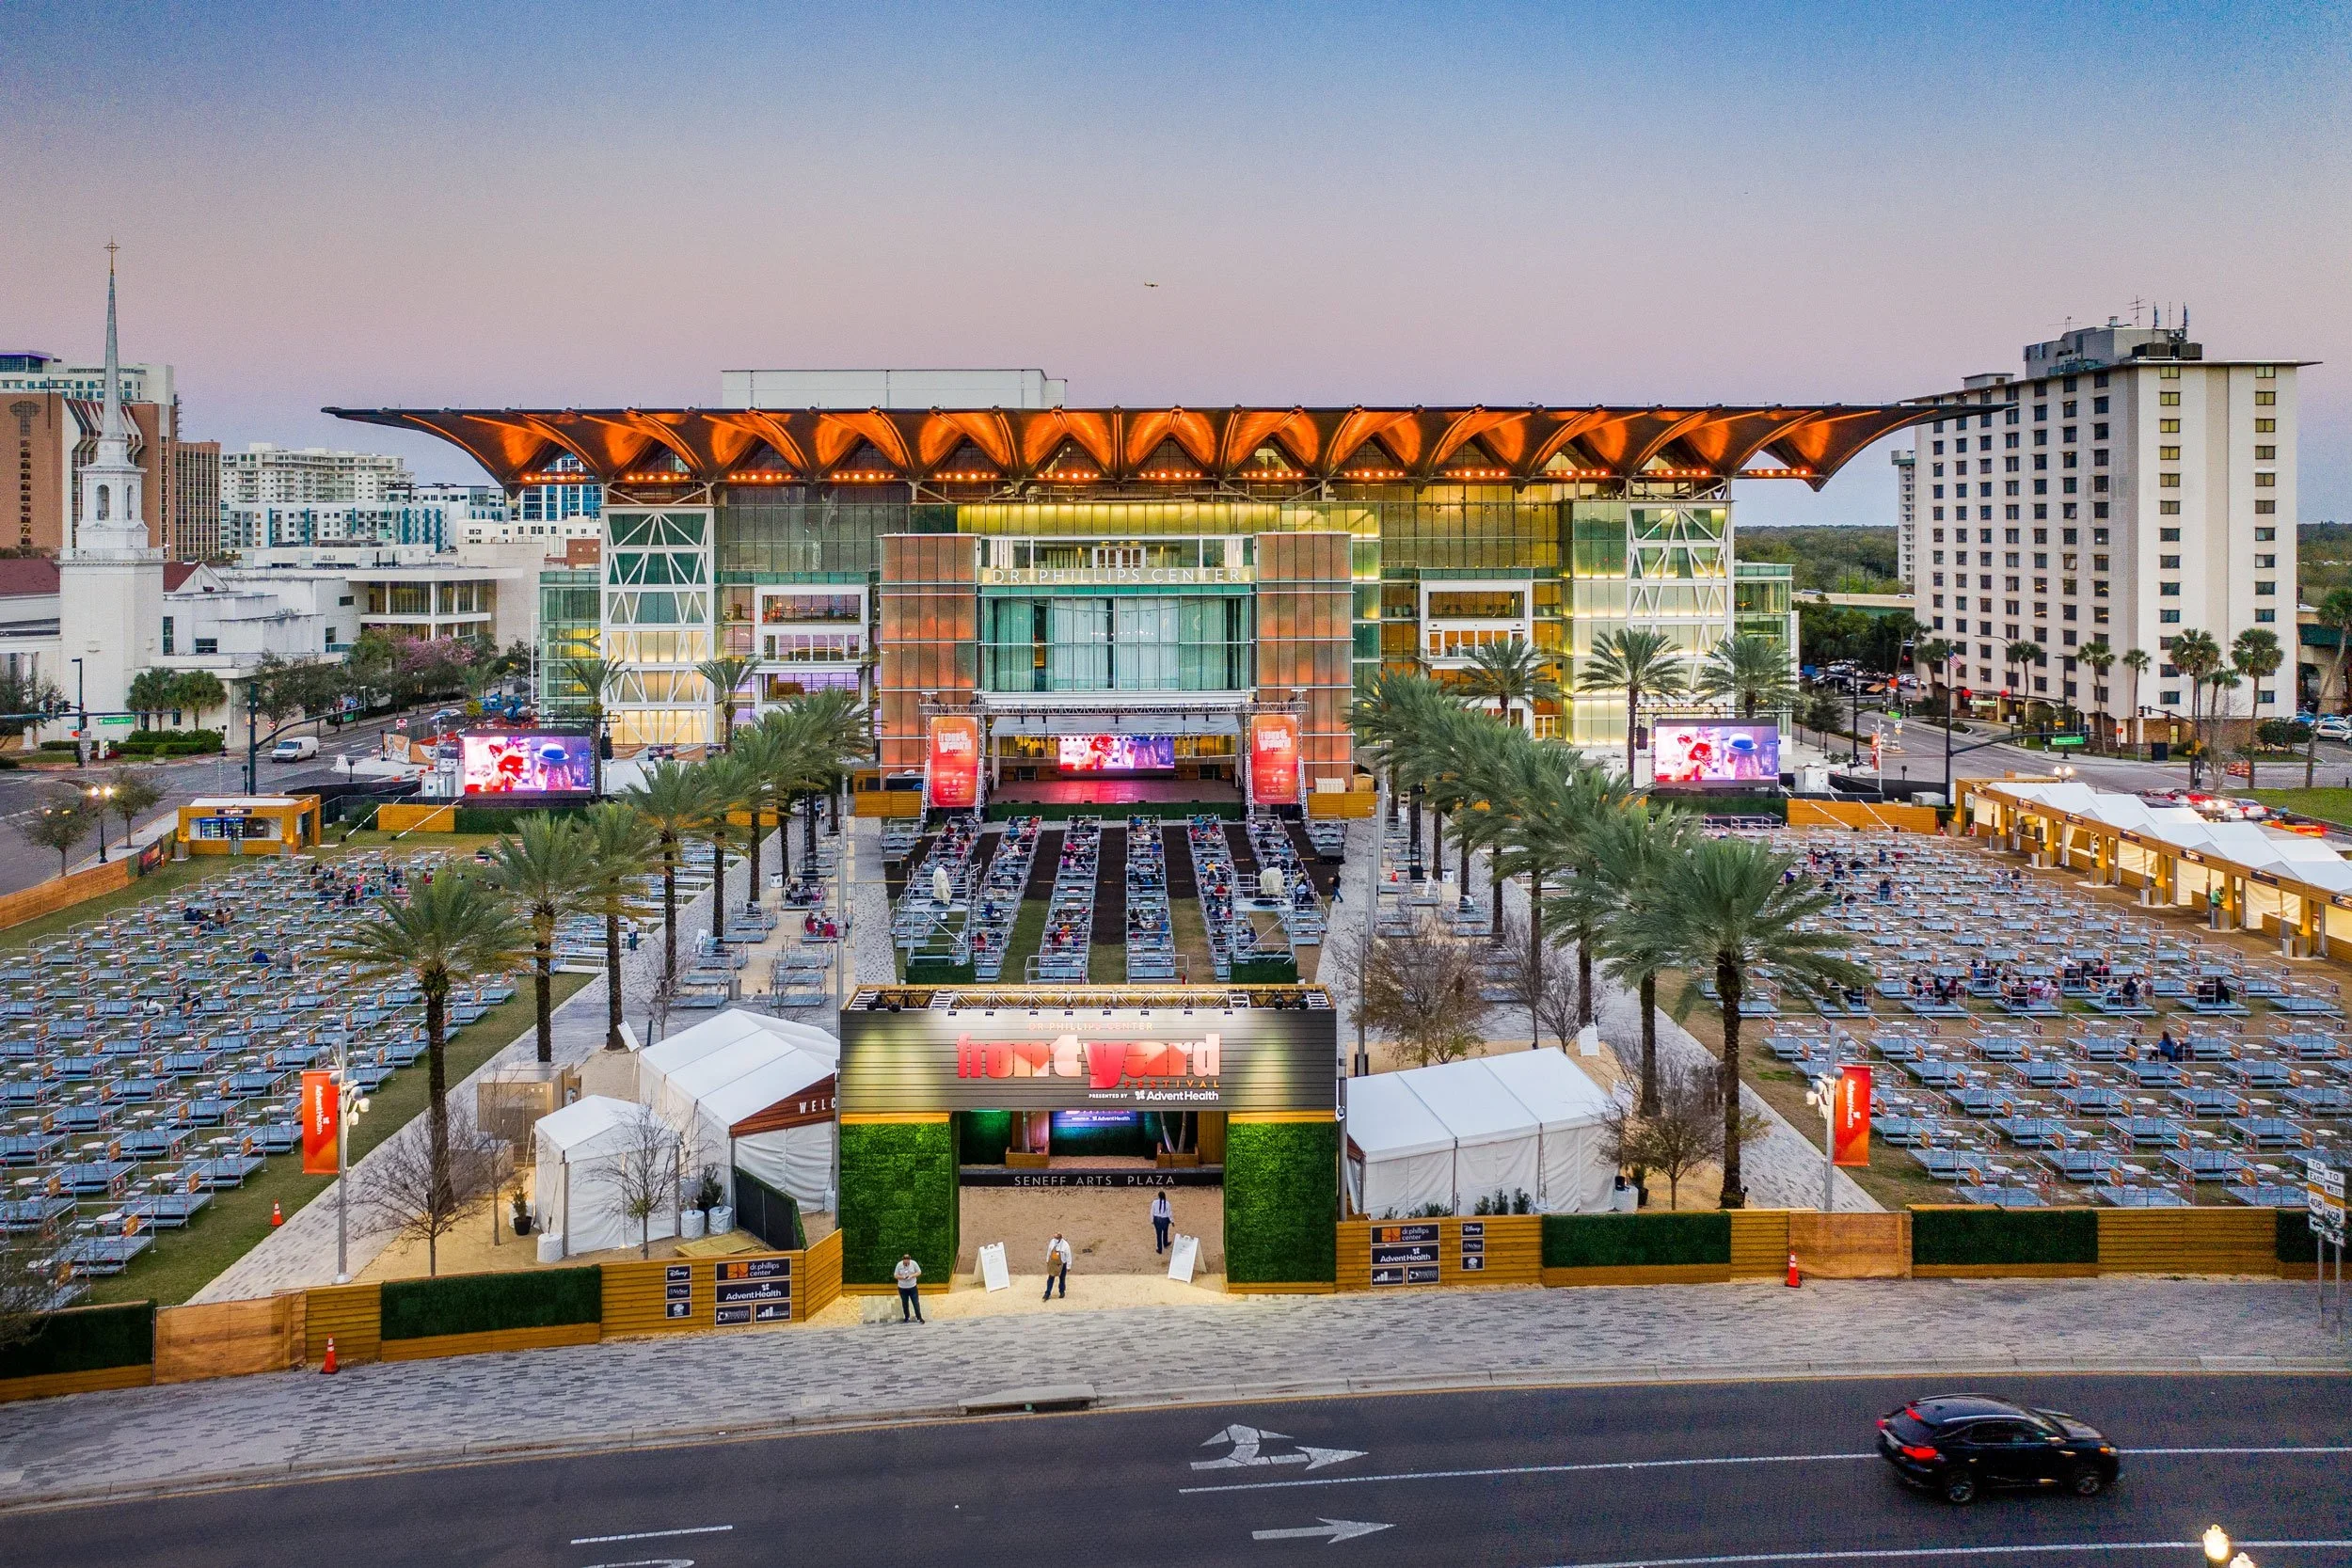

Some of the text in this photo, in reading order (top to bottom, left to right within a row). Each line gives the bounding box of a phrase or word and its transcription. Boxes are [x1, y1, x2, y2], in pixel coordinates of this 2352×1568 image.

[993, 568, 1241, 582] DR. PHILLIPS CENTER
[1028, 1022, 1153, 1031] DR PHILLIPS CENTER
[1124, 1080, 1220, 1088] FESTIVAL
[2311, 1161, 2321, 1170] TO
[1014, 1175, 1175, 1186] SENEFF ARTS PLAZA
[2309, 1172, 2323, 1183] EAST
[2328, 1172, 2339, 1181] TO
[2310, 1197, 2322, 1210] 408
[2326, 1210, 2341, 1222] 408
[1463, 1225, 1481, 1233] Disney
